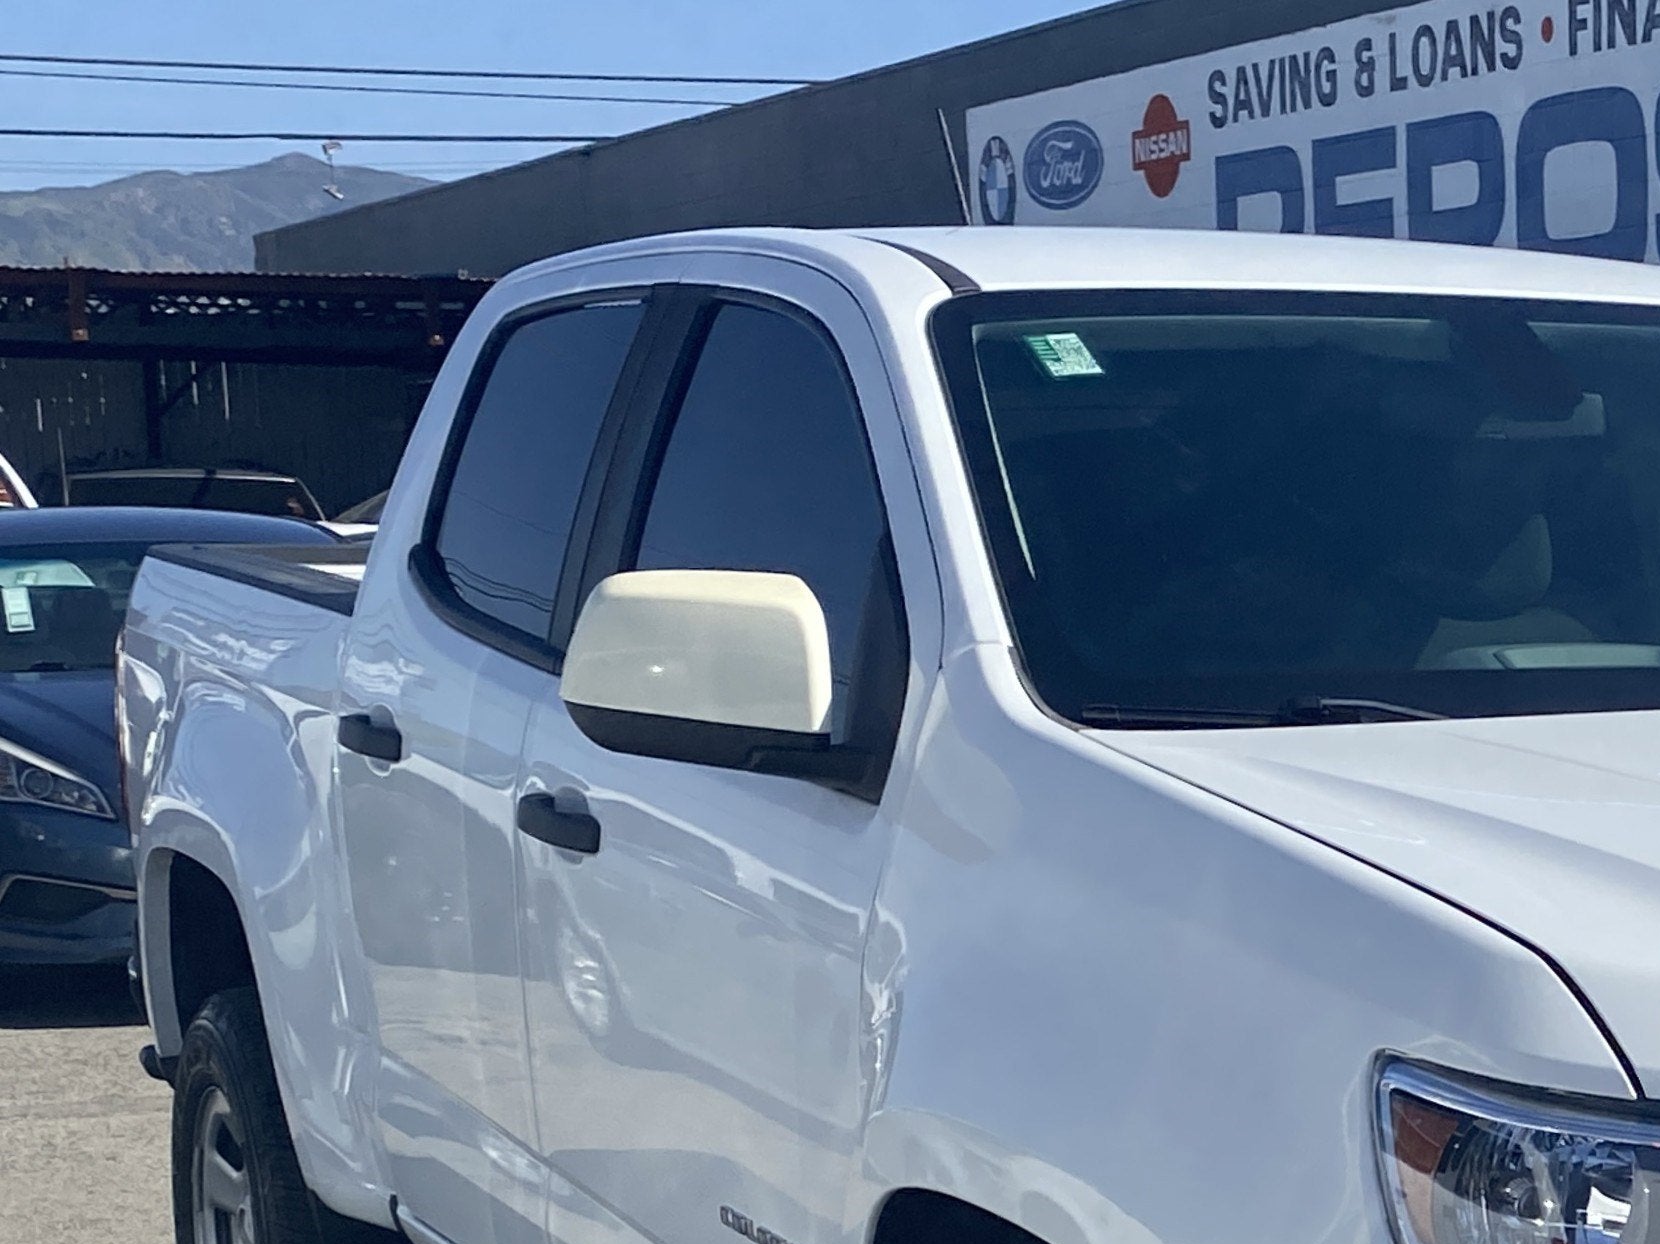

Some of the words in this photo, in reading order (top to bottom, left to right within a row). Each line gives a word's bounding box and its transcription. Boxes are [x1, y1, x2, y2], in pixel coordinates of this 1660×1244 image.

[1206, 46, 1338, 129] SAVING
[1354, 37, 1377, 98] &
[1388, 5, 1524, 92] LOANS
[1040, 140, 1085, 188] Ford
[1134, 129, 1188, 163] NISSAN
